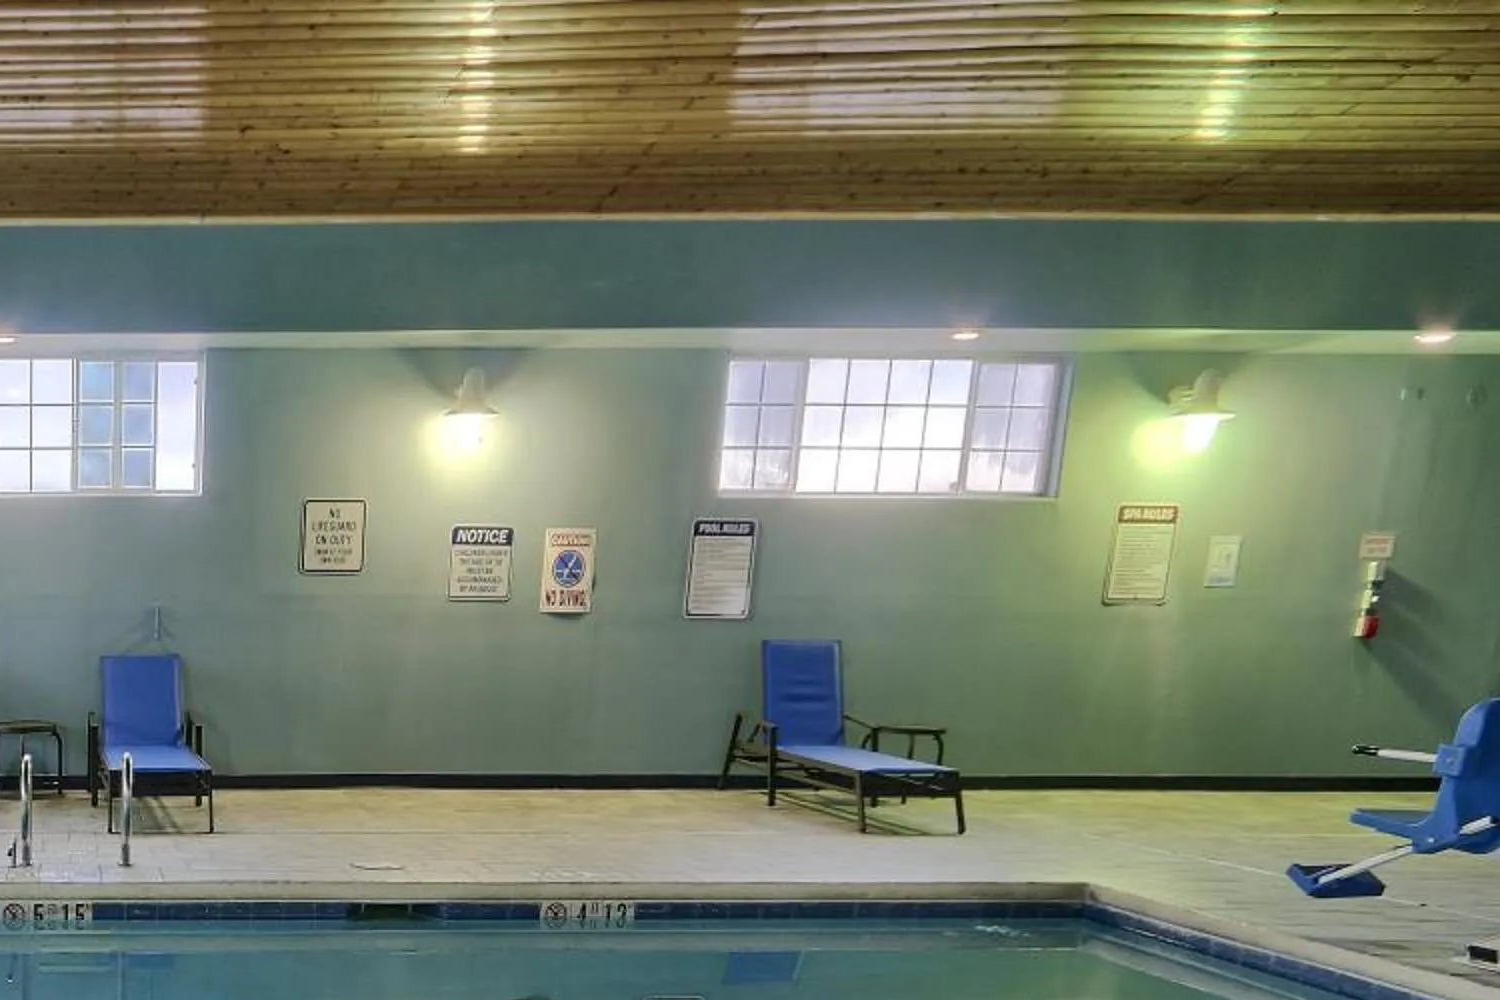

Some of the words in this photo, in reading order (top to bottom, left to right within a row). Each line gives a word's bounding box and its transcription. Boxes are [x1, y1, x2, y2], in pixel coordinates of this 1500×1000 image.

[456, 529, 509, 543] NOTICE
[545, 590, 557, 607] NO
[559, 590, 587, 607] DIVING
